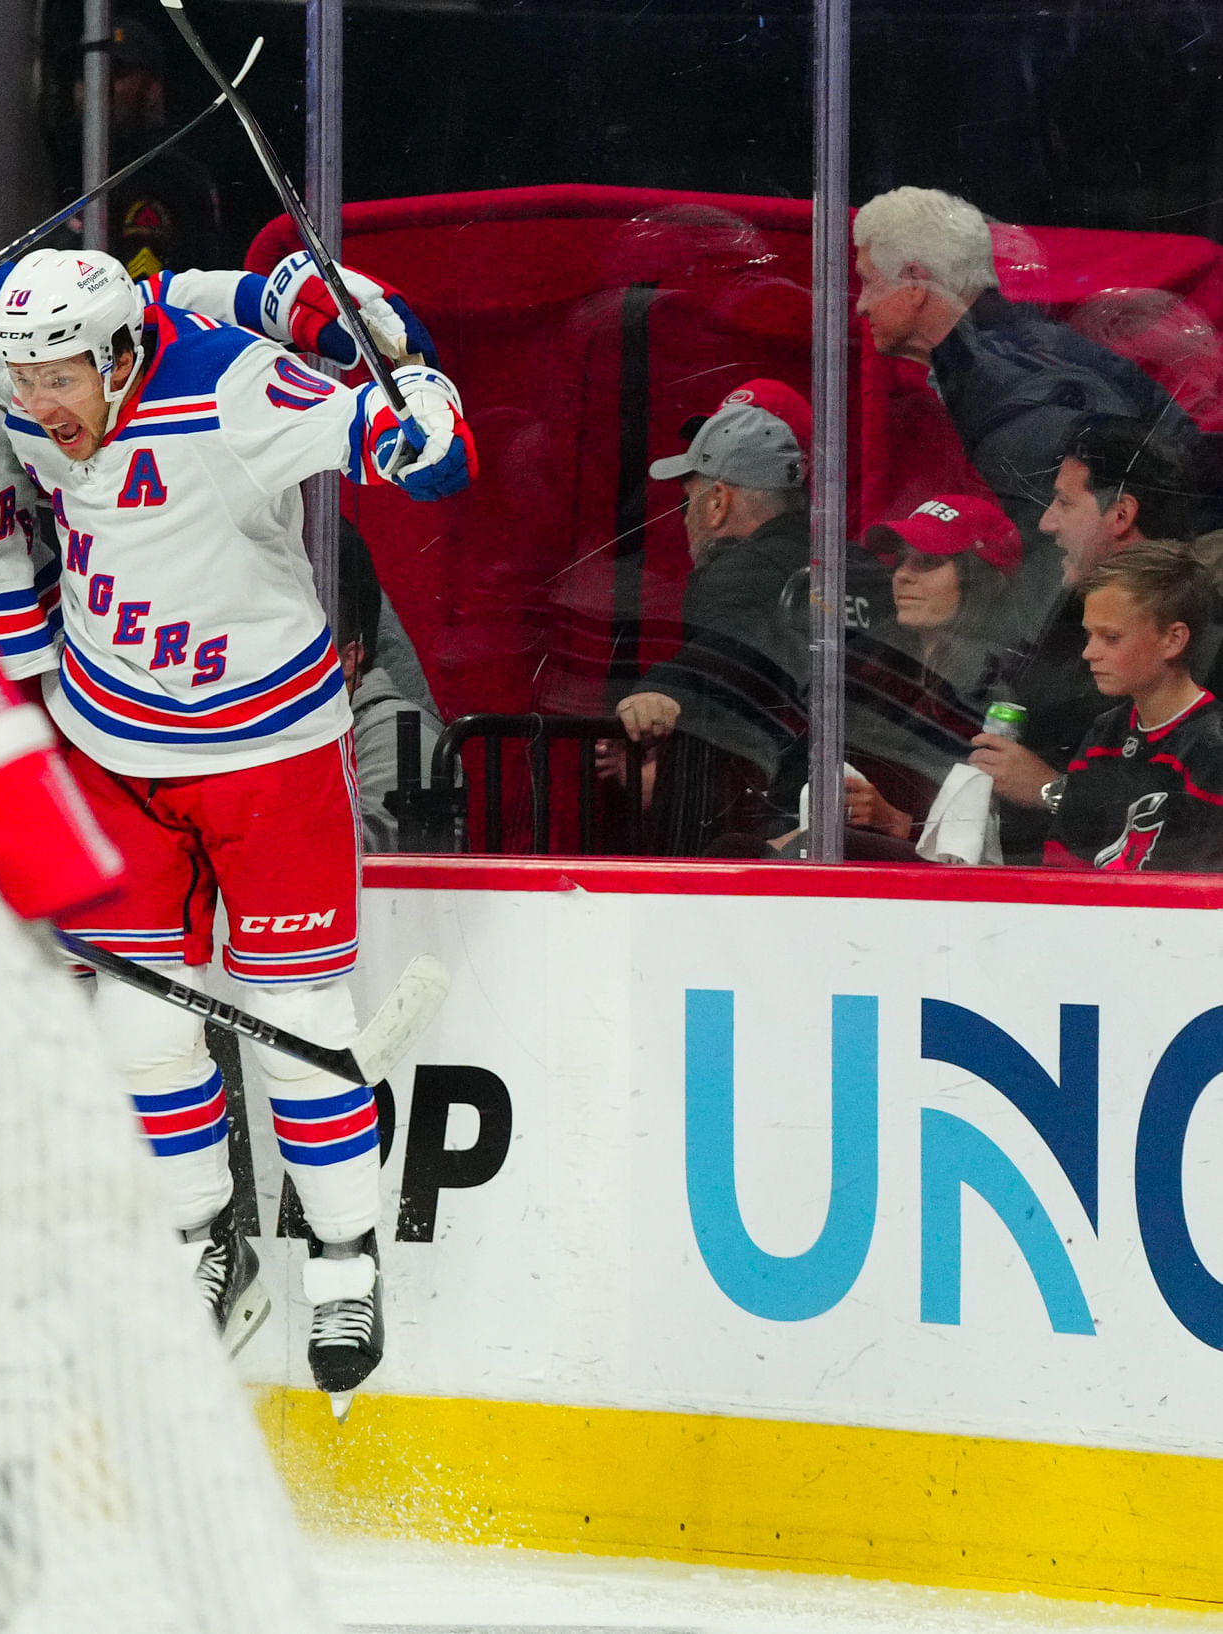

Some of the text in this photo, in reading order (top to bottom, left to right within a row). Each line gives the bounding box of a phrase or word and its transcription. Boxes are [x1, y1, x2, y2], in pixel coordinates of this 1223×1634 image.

[77, 267, 106, 289] Benjamin
[87, 277, 109, 293] Moore
[6, 290, 32, 307] 10
[0, 331, 34, 340] CCM
[265, 357, 336, 411] 10
[117, 448, 168, 508] A
[240, 908, 337, 934] CCM
[166, 981, 278, 1045] BAUER
